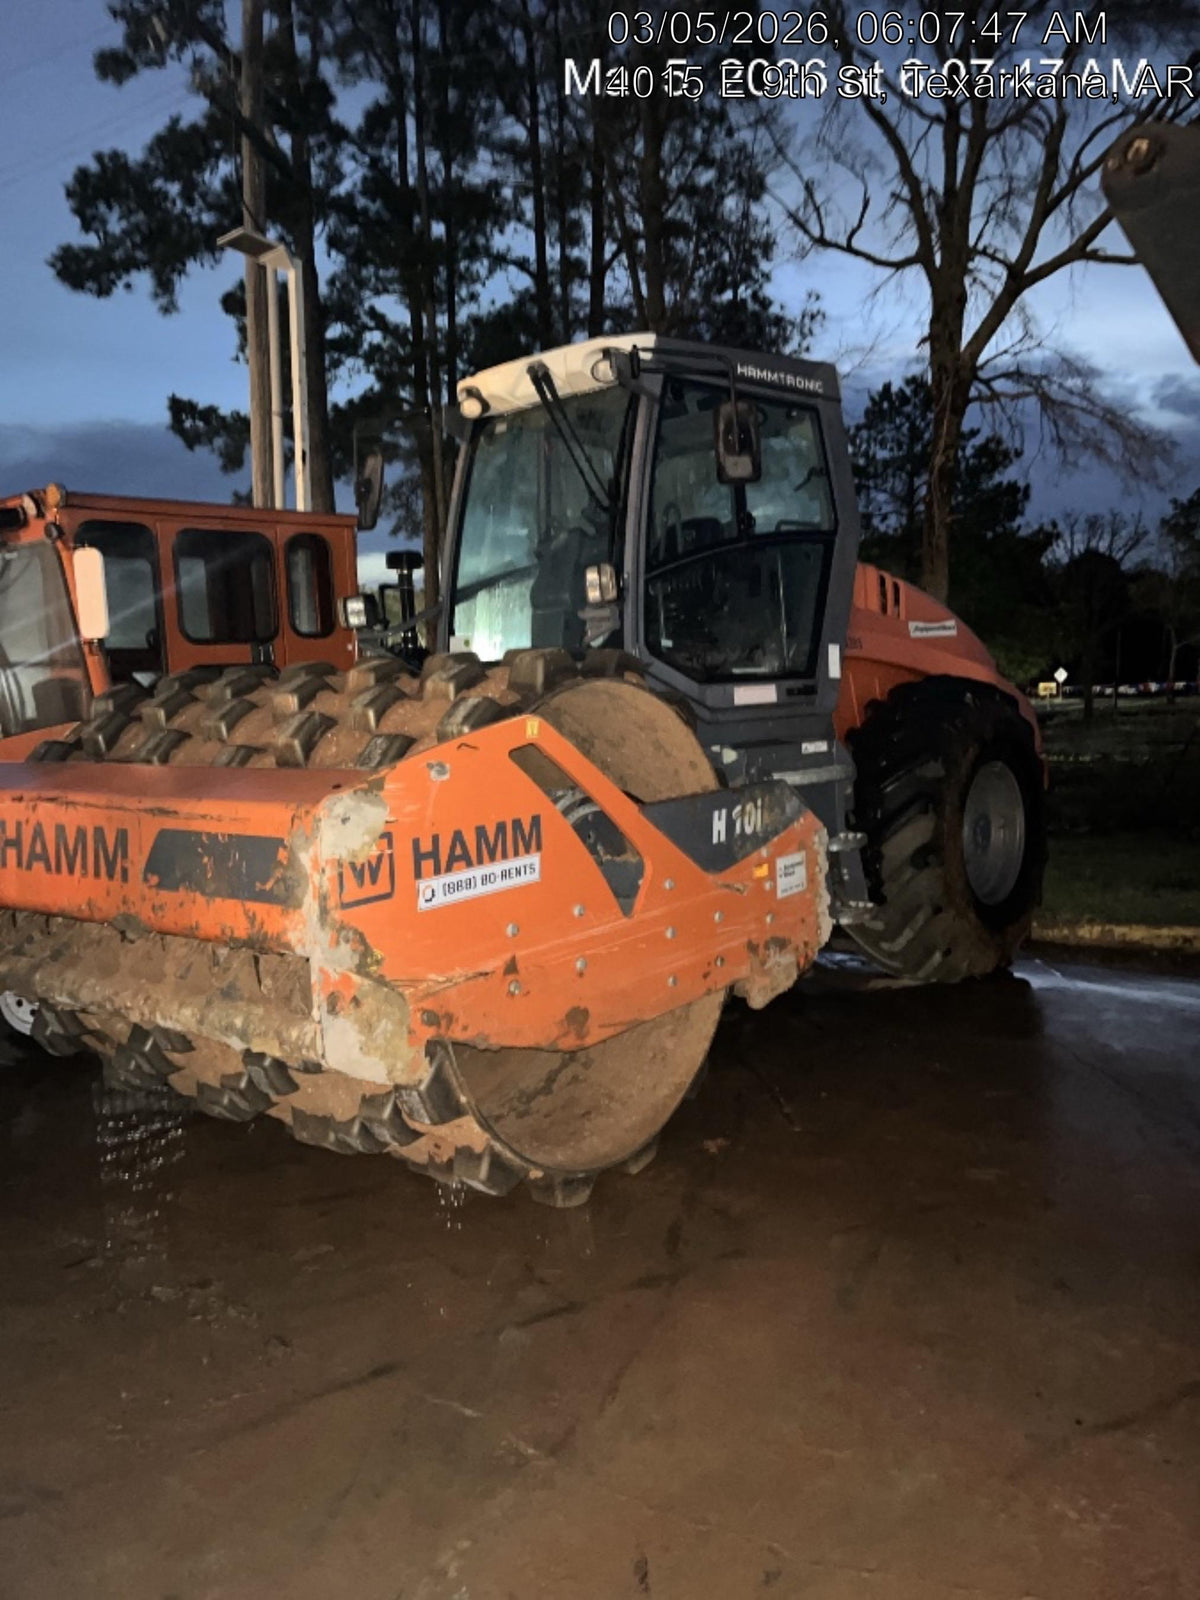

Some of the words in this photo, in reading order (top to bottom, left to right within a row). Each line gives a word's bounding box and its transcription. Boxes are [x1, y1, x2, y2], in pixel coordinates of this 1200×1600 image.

[0, 819, 129, 883] HAMM
[412, 814, 542, 881] HAMM
[712, 808, 727, 844] H
